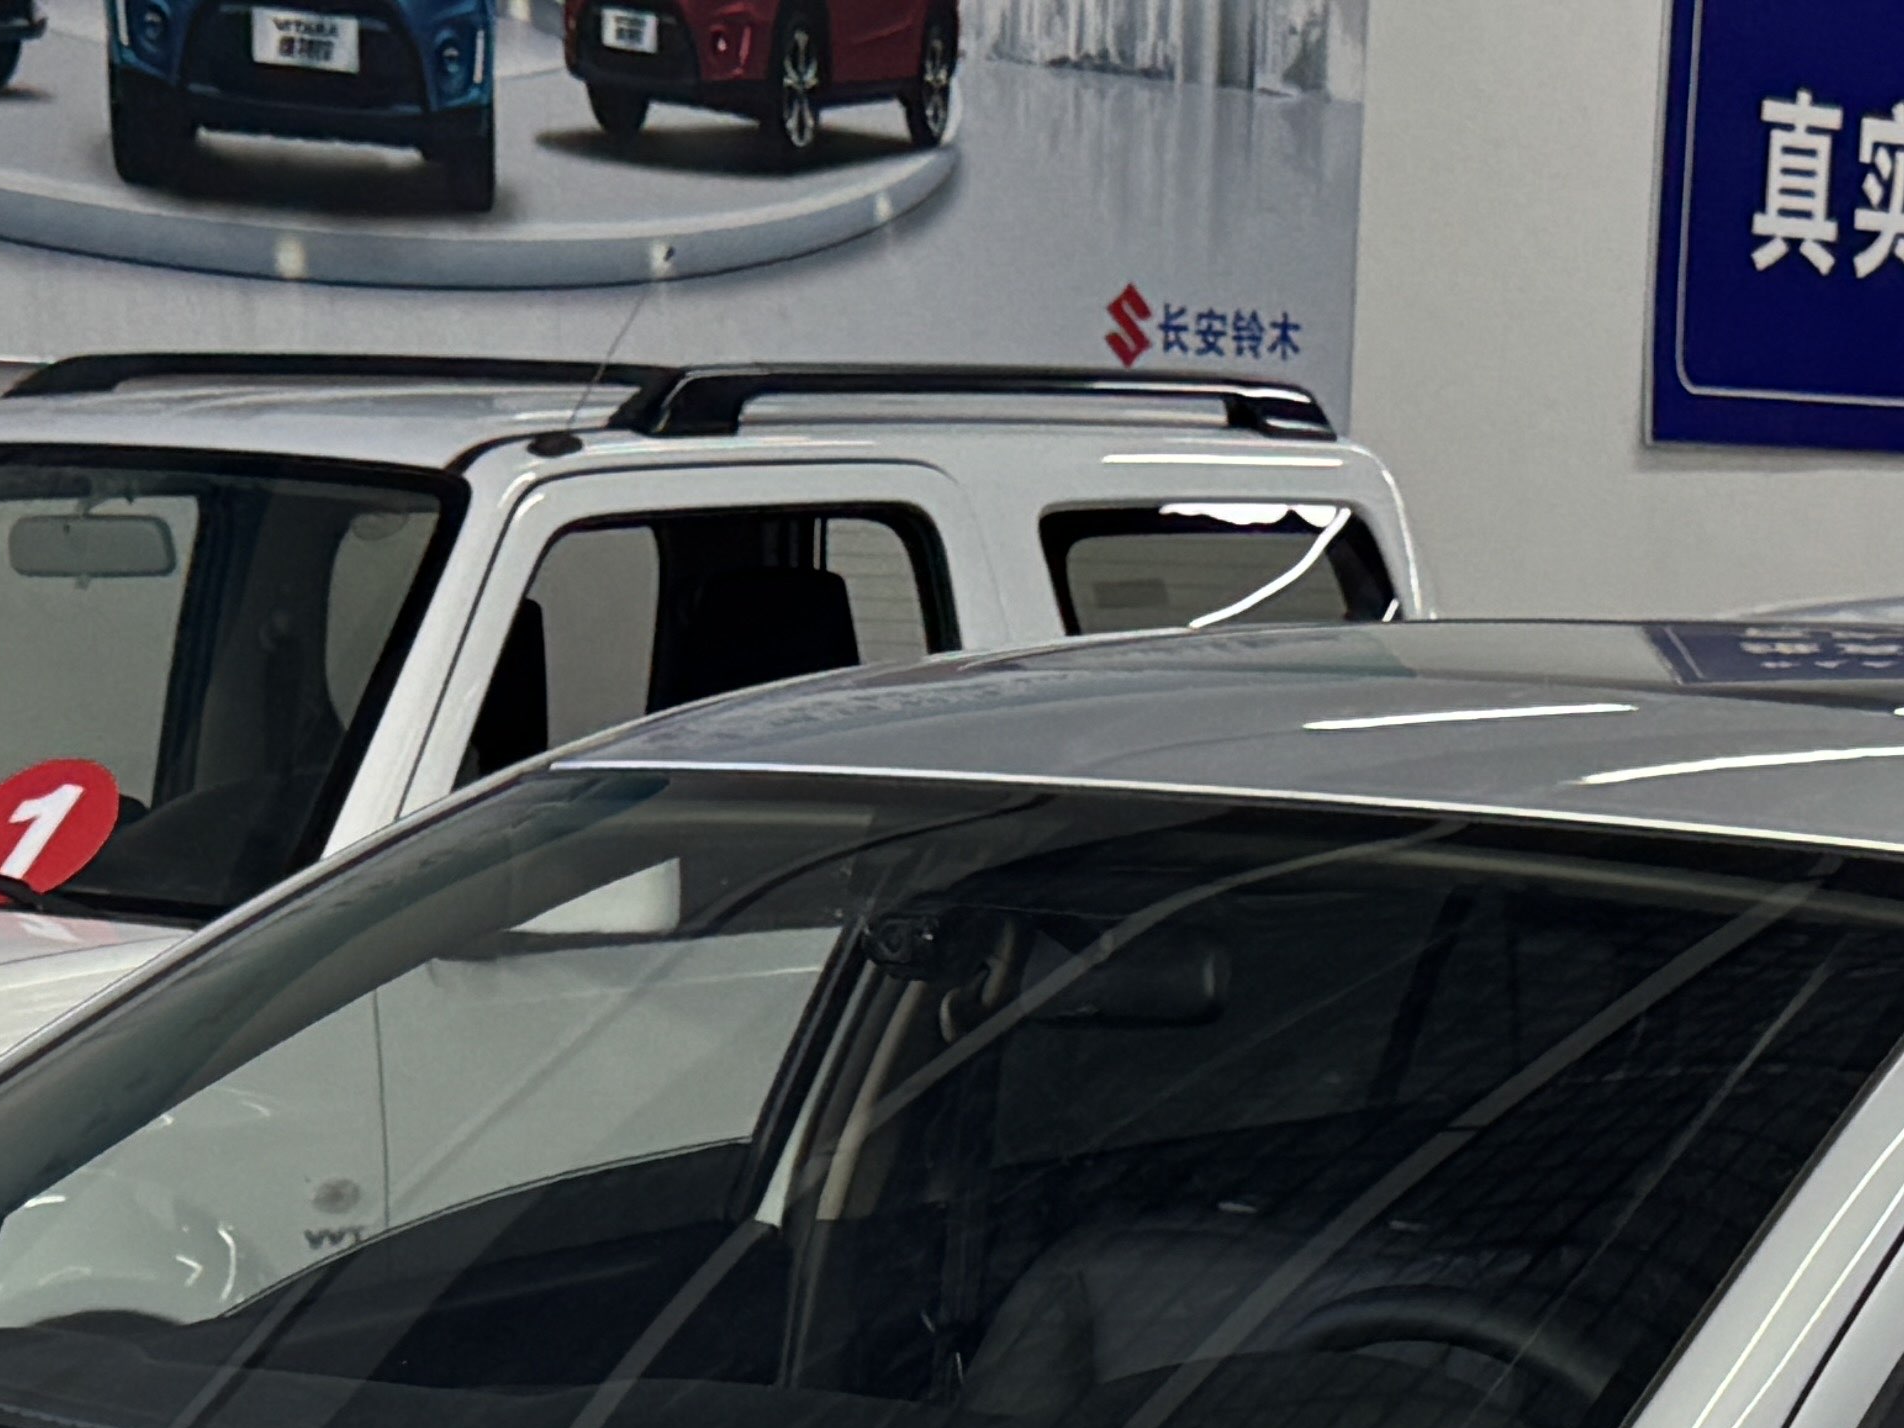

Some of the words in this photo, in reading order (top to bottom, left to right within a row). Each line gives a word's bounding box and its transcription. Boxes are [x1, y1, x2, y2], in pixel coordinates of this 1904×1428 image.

[1158, 303, 1302, 360] 长安铃木
[0, 783, 85, 880] 1
